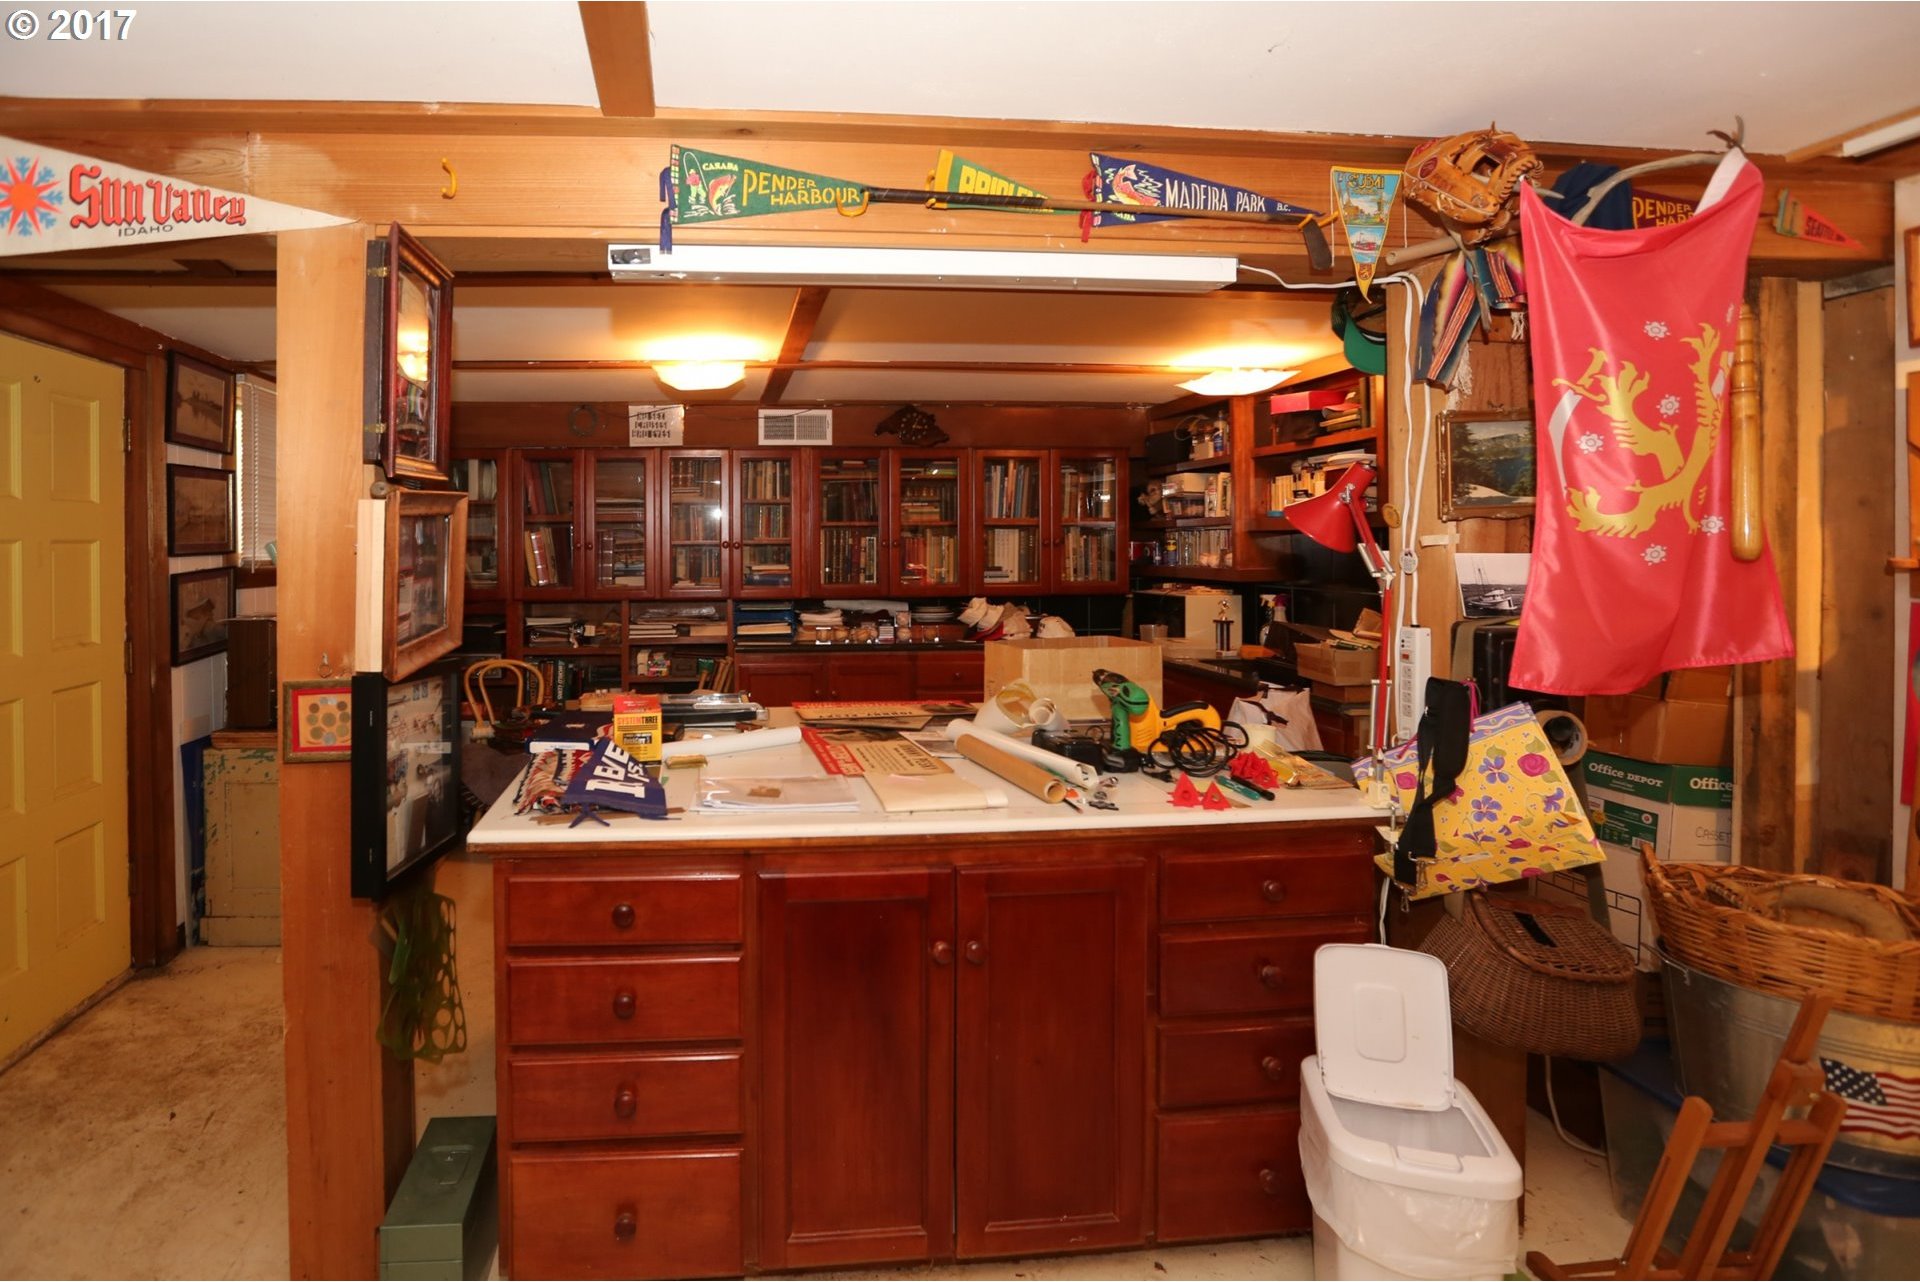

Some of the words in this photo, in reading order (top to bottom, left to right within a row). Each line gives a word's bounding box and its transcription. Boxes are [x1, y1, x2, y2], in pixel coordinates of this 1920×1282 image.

[69, 164, 145, 228] Sun
[146, 178, 246, 226] Valley
[743, 169, 817, 206] PENDER
[771, 187, 860, 206] HARBOUR
[1235, 191, 1266, 212] PARK
[1632, 196, 1692, 229] PENDER
[118, 224, 174, 237] IDAHO
[1588, 762, 1625, 779] Office
[1627, 773, 1664, 787] DEPOT
[1689, 777, 1733, 791] Office
